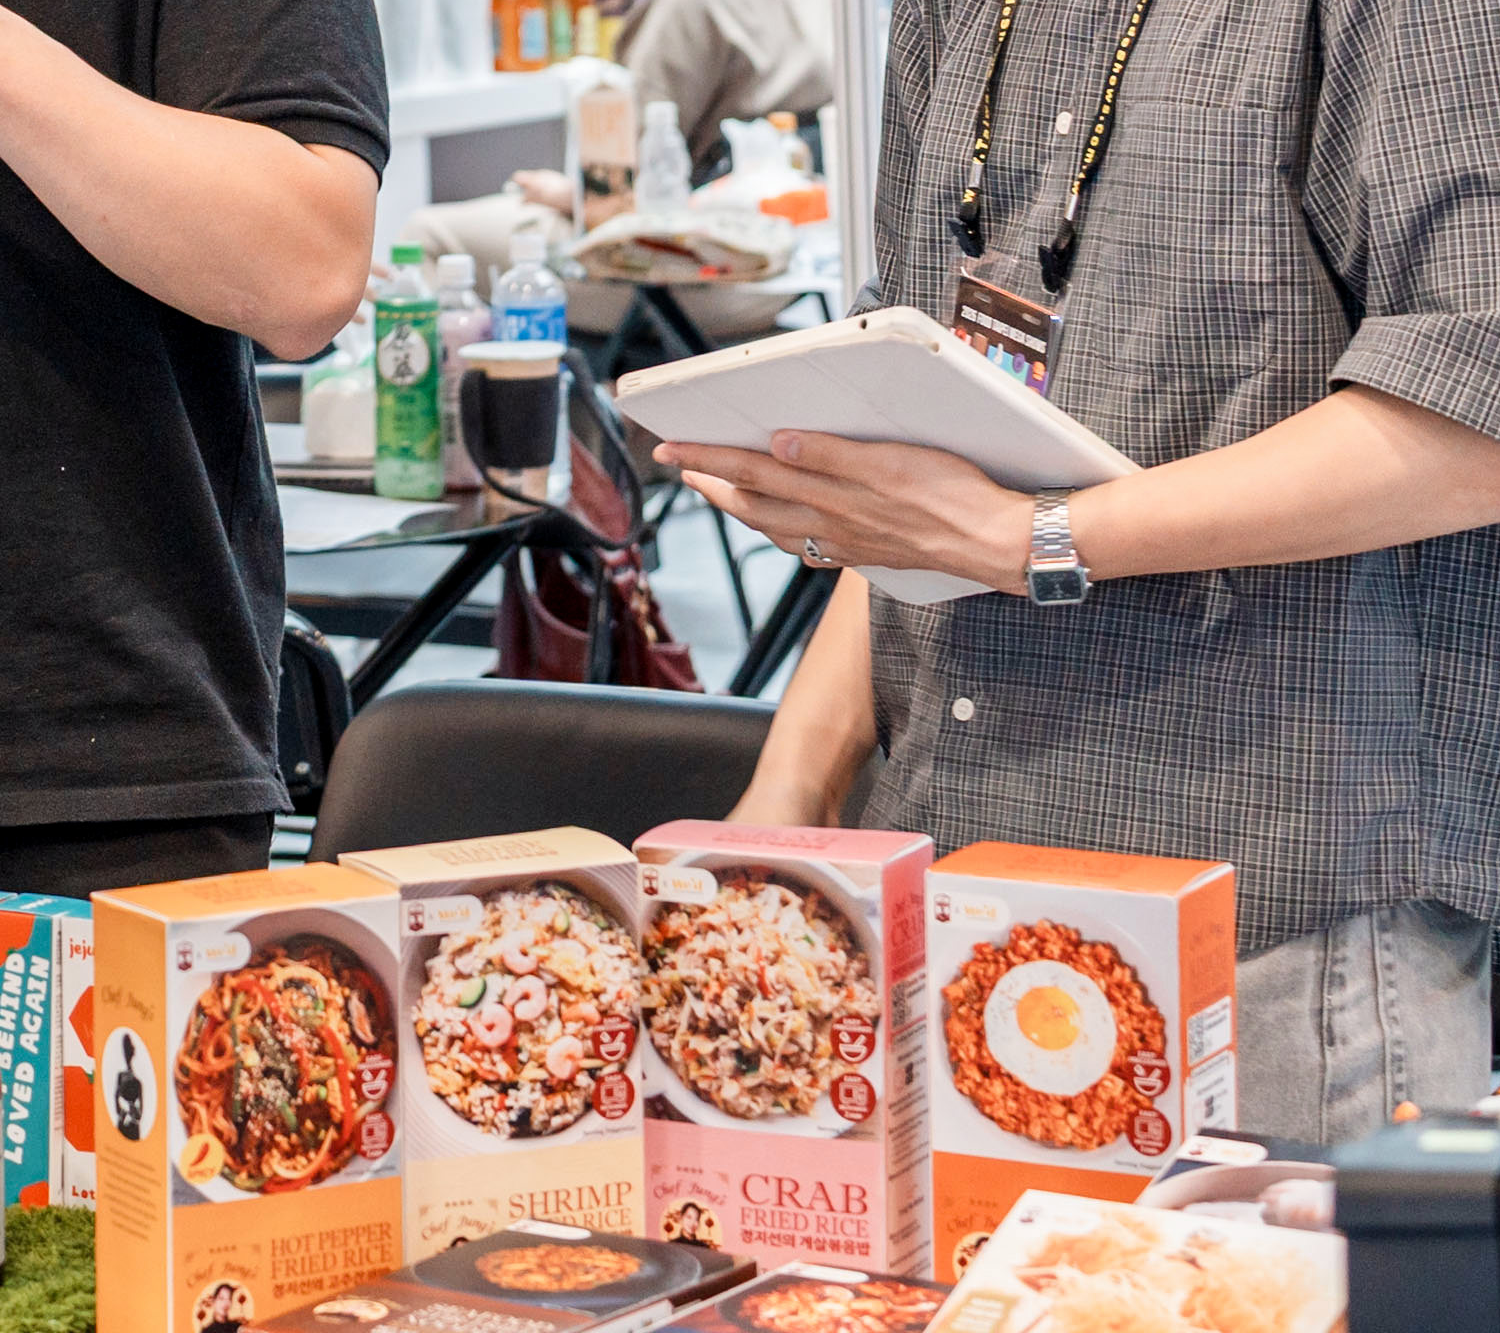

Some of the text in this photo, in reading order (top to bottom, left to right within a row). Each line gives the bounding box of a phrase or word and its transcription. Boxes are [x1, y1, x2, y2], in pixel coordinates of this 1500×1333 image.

[0, 952, 26, 1071] BEHIND
[3, 955, 50, 1166] LOVED AGAIN
[508, 1180, 633, 1220] SHRIMP
[741, 1173, 869, 1216] CRAB
[583, 1208, 633, 1230] RICE
[740, 1206, 870, 1239] FRIED RICE
[271, 1221, 393, 1258] HOT PEPPER
[271, 1243, 394, 1280] FRIED RICE
